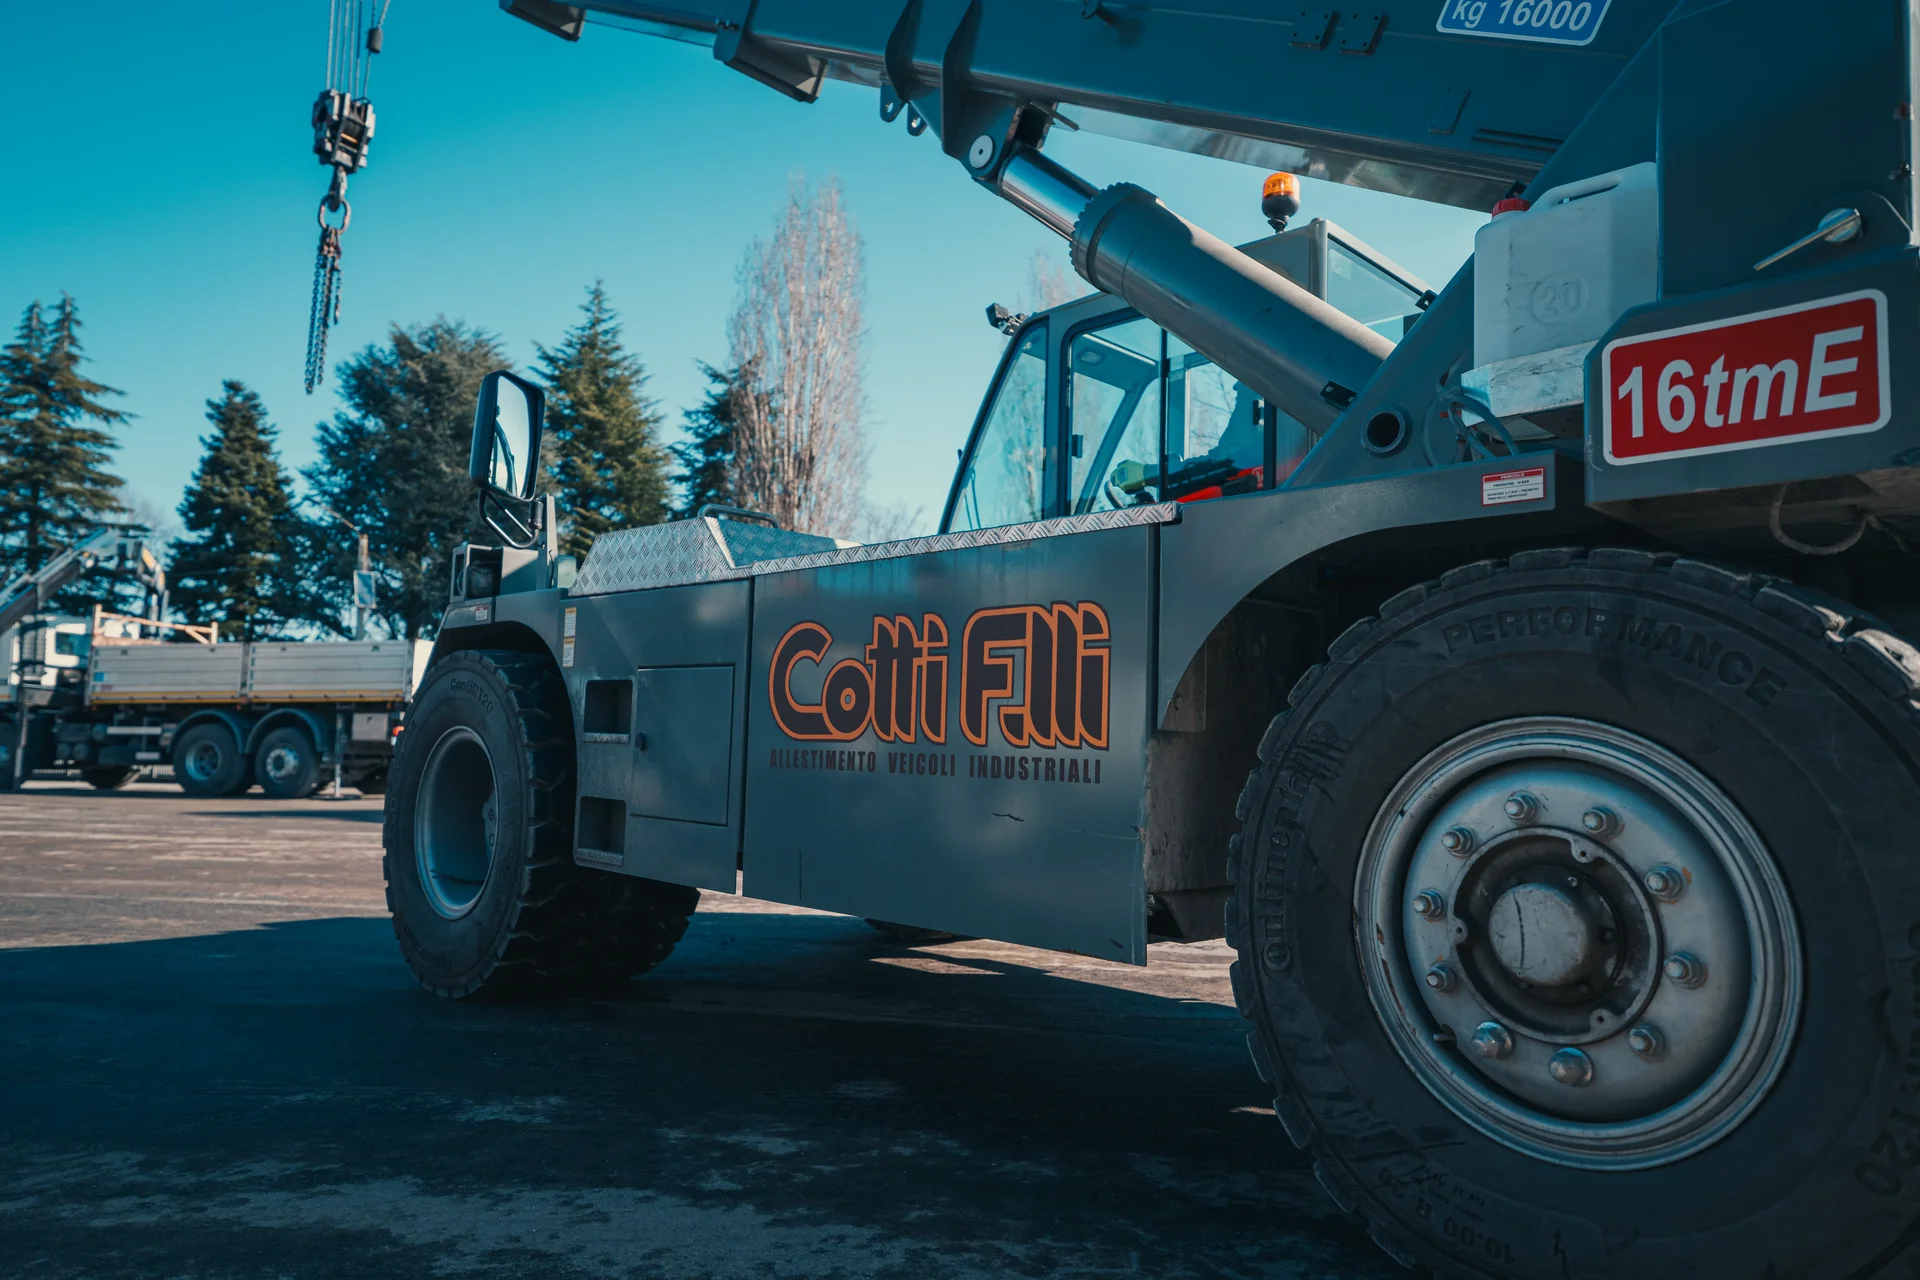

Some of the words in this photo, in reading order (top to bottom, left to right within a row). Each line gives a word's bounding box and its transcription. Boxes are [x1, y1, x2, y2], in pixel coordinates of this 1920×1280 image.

[1451, 0, 1487, 28] kg
[1498, 0, 1592, 31] 16000
[1618, 325, 1865, 438] 16tmE
[768, 611, 949, 745] Cotti
[1440, 605, 1789, 709] PERFORMANCE
[769, 748, 876, 773] ALLESTIMENTO
[888, 752, 956, 777] VEICOLI
[969, 754, 1102, 784] INDUSTRIALI
[1443, 1216, 1517, 1264] 10.00
